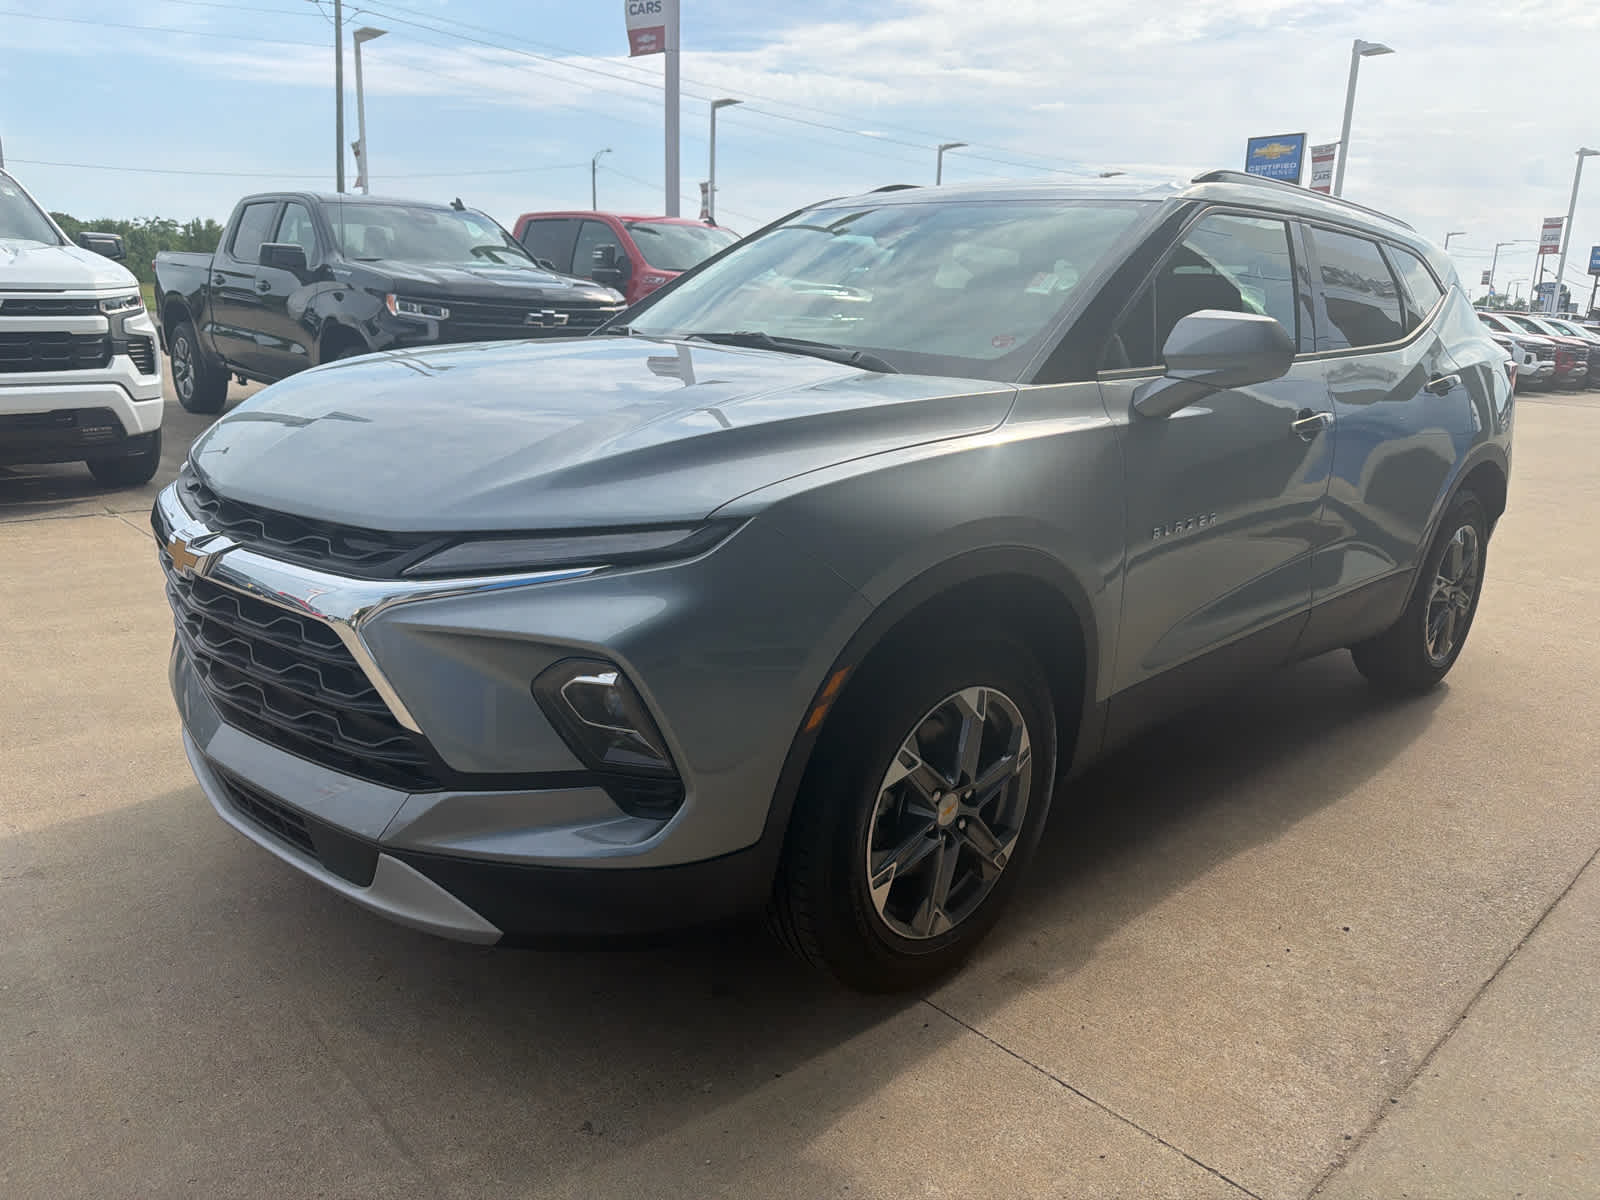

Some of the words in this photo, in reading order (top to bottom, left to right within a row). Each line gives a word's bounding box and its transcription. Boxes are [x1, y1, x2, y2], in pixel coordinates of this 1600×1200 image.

[629, 0, 662, 16] CARS
[1248, 162, 1297, 173] CERTIFIED
[1152, 512, 1217, 542] BLAZER
